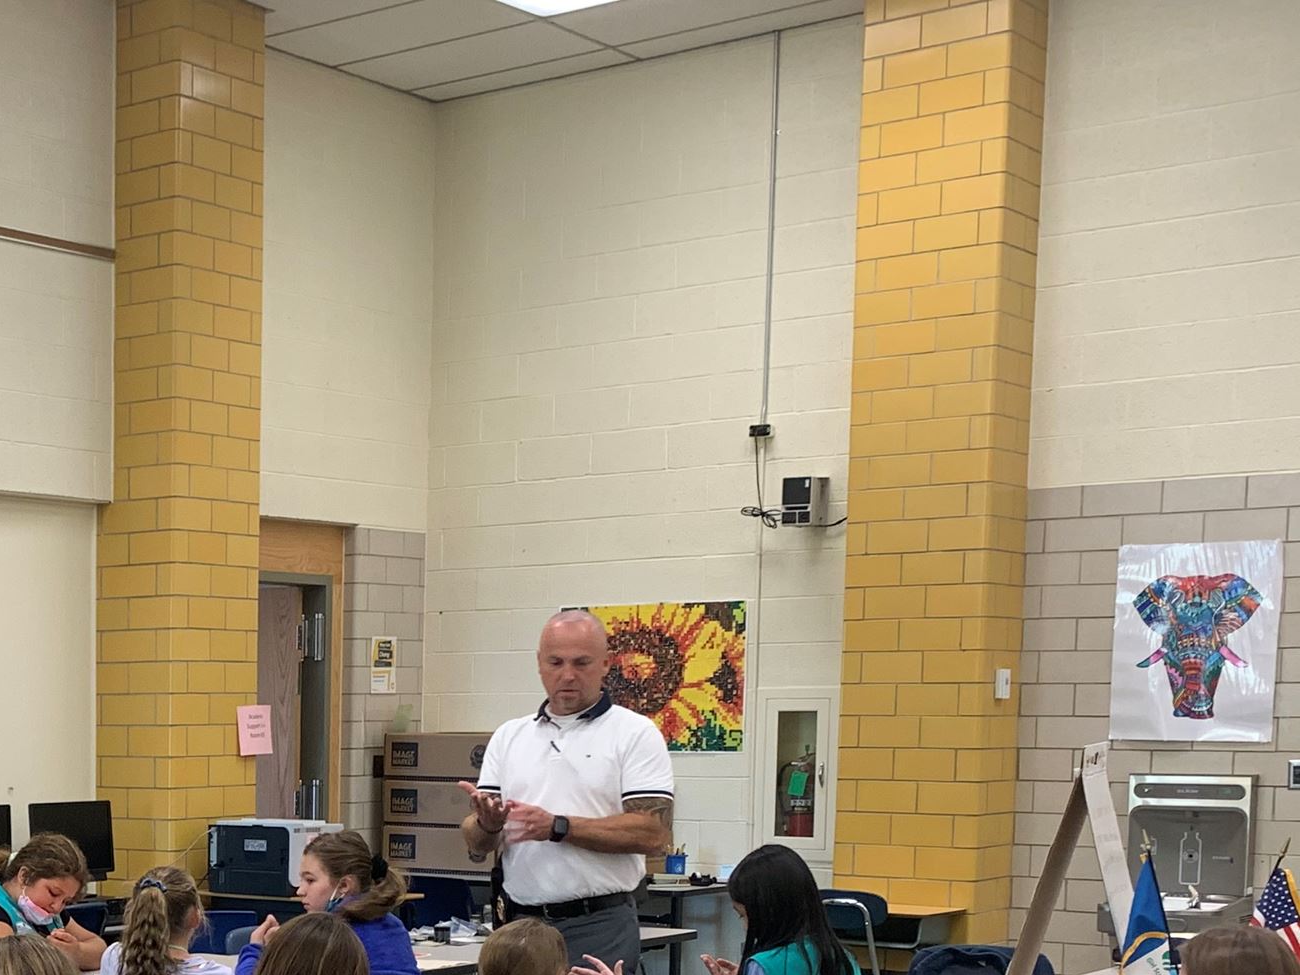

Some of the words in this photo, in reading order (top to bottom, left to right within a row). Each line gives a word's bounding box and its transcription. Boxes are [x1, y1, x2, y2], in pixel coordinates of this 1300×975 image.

[392, 750, 415, 758] IMAGE
[392, 796, 415, 804] IMAGE
[392, 804, 414, 812] MARKET
[390, 841, 413, 850] IMAGE
[390, 849, 412, 857] MARKET
